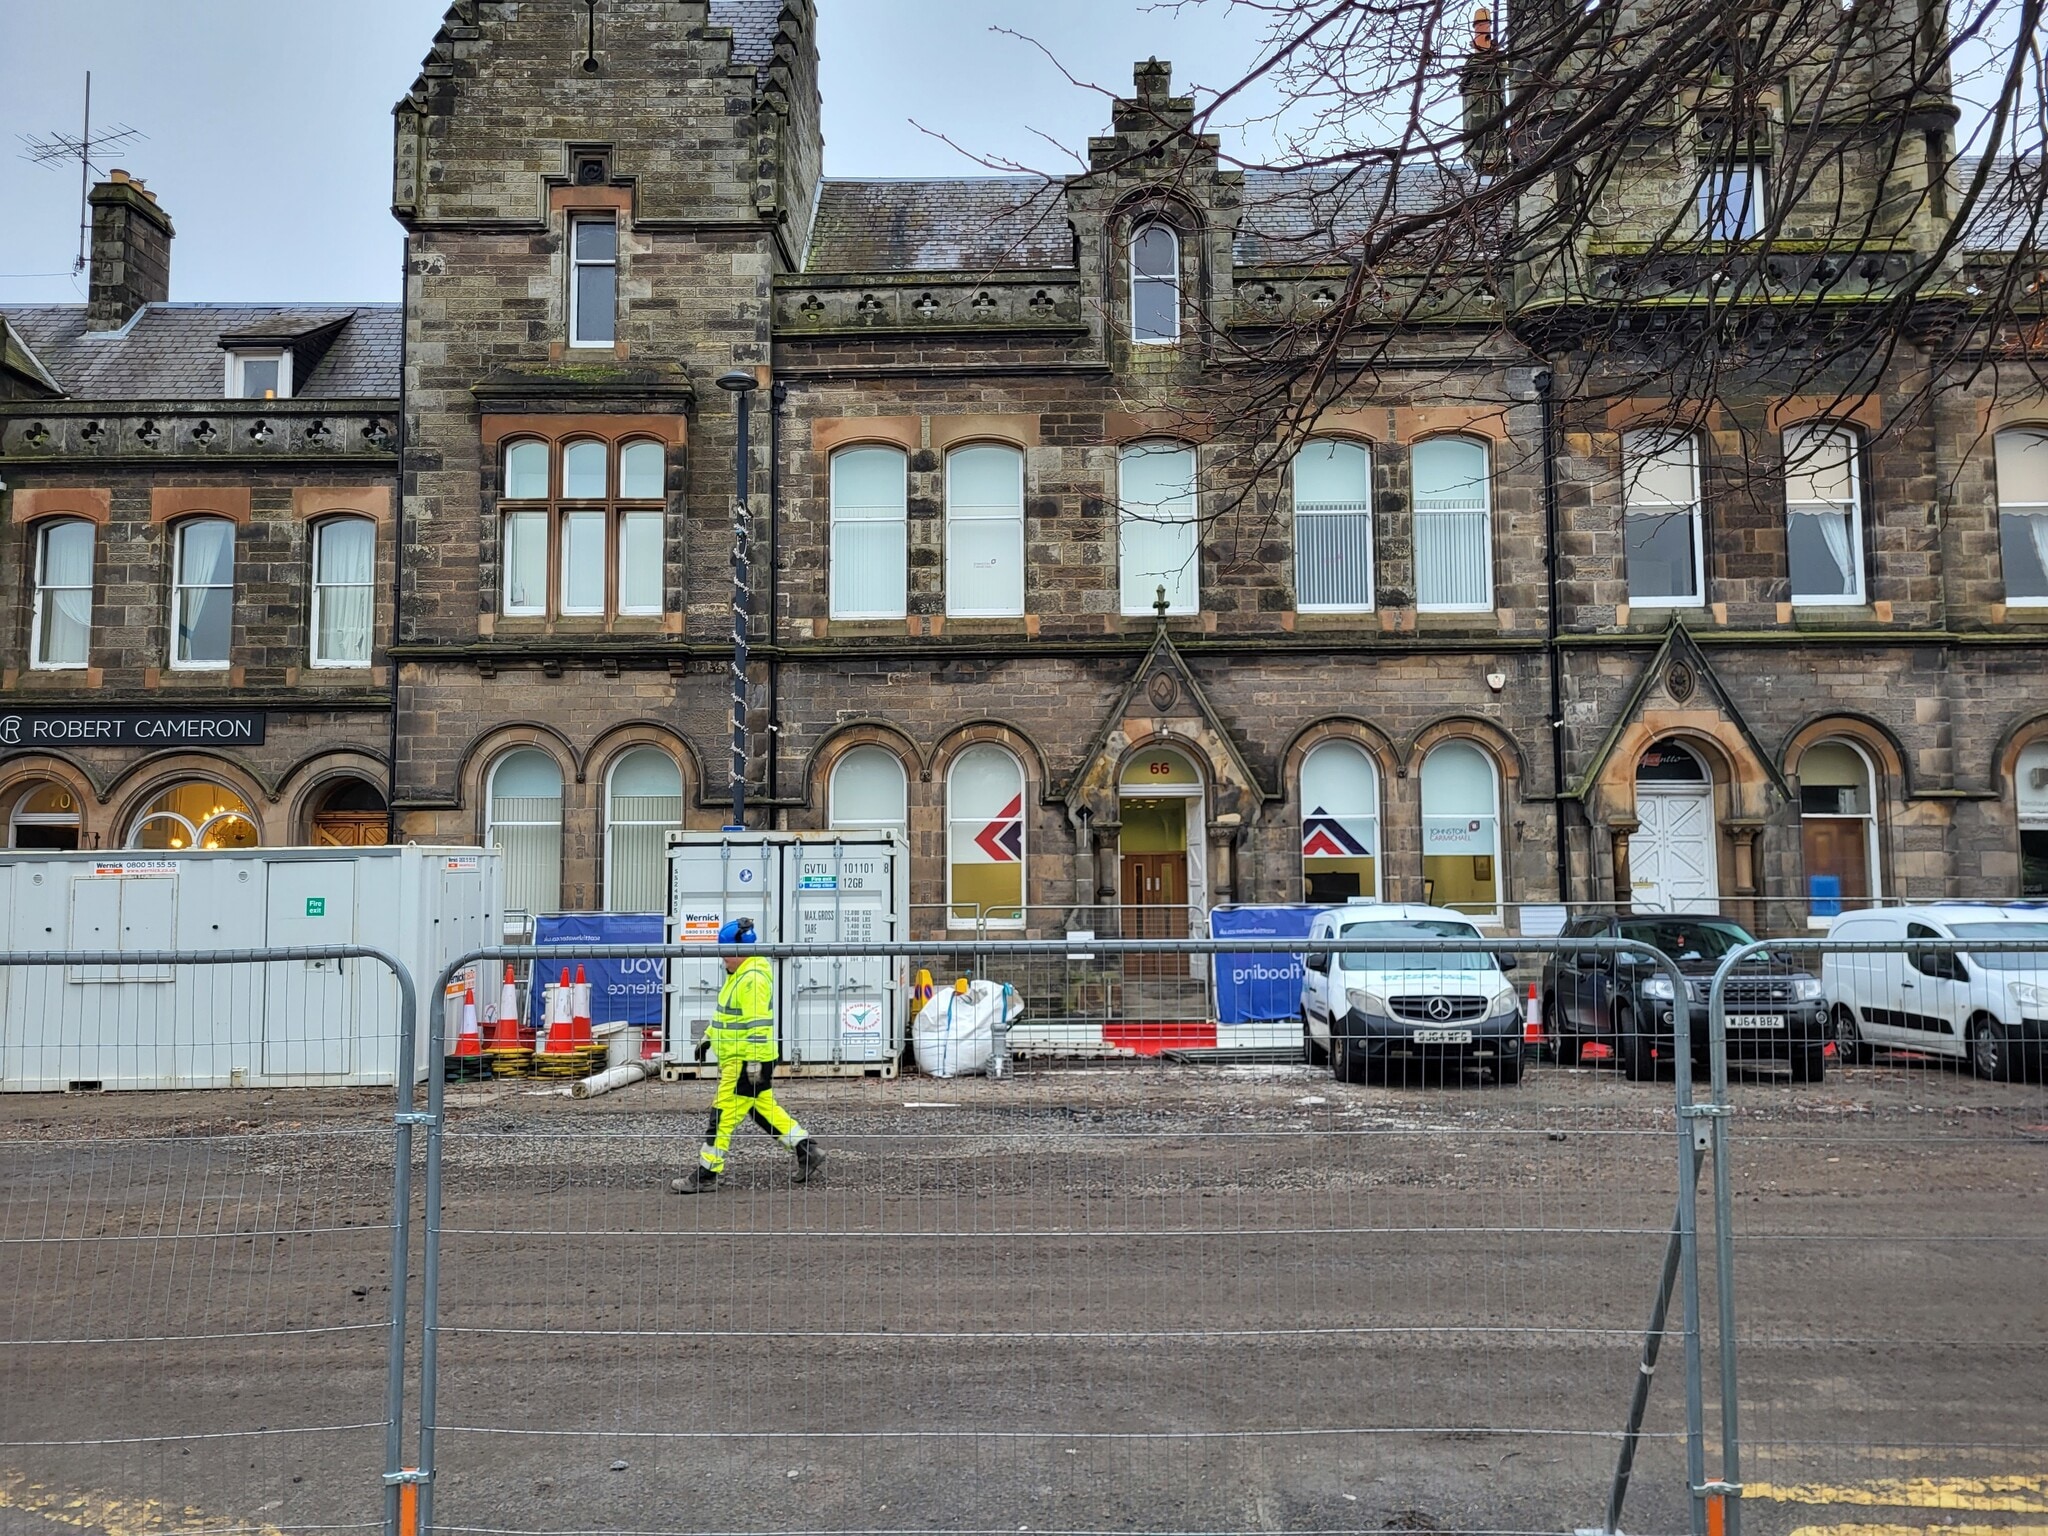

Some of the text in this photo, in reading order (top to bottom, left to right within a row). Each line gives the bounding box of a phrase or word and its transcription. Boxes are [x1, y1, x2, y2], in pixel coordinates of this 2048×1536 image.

[33, 720, 126, 738] ROBERT
[134, 719, 252, 738] CAMERON
[1150, 762, 1170, 775] 66
[804, 862, 889, 874] GVTU 101101 8
[843, 878, 863, 889] 12GB
[686, 914, 720, 922] Wernick
[804, 923, 817, 934] TARE
[1760, 1016, 1779, 1026] BBZ
